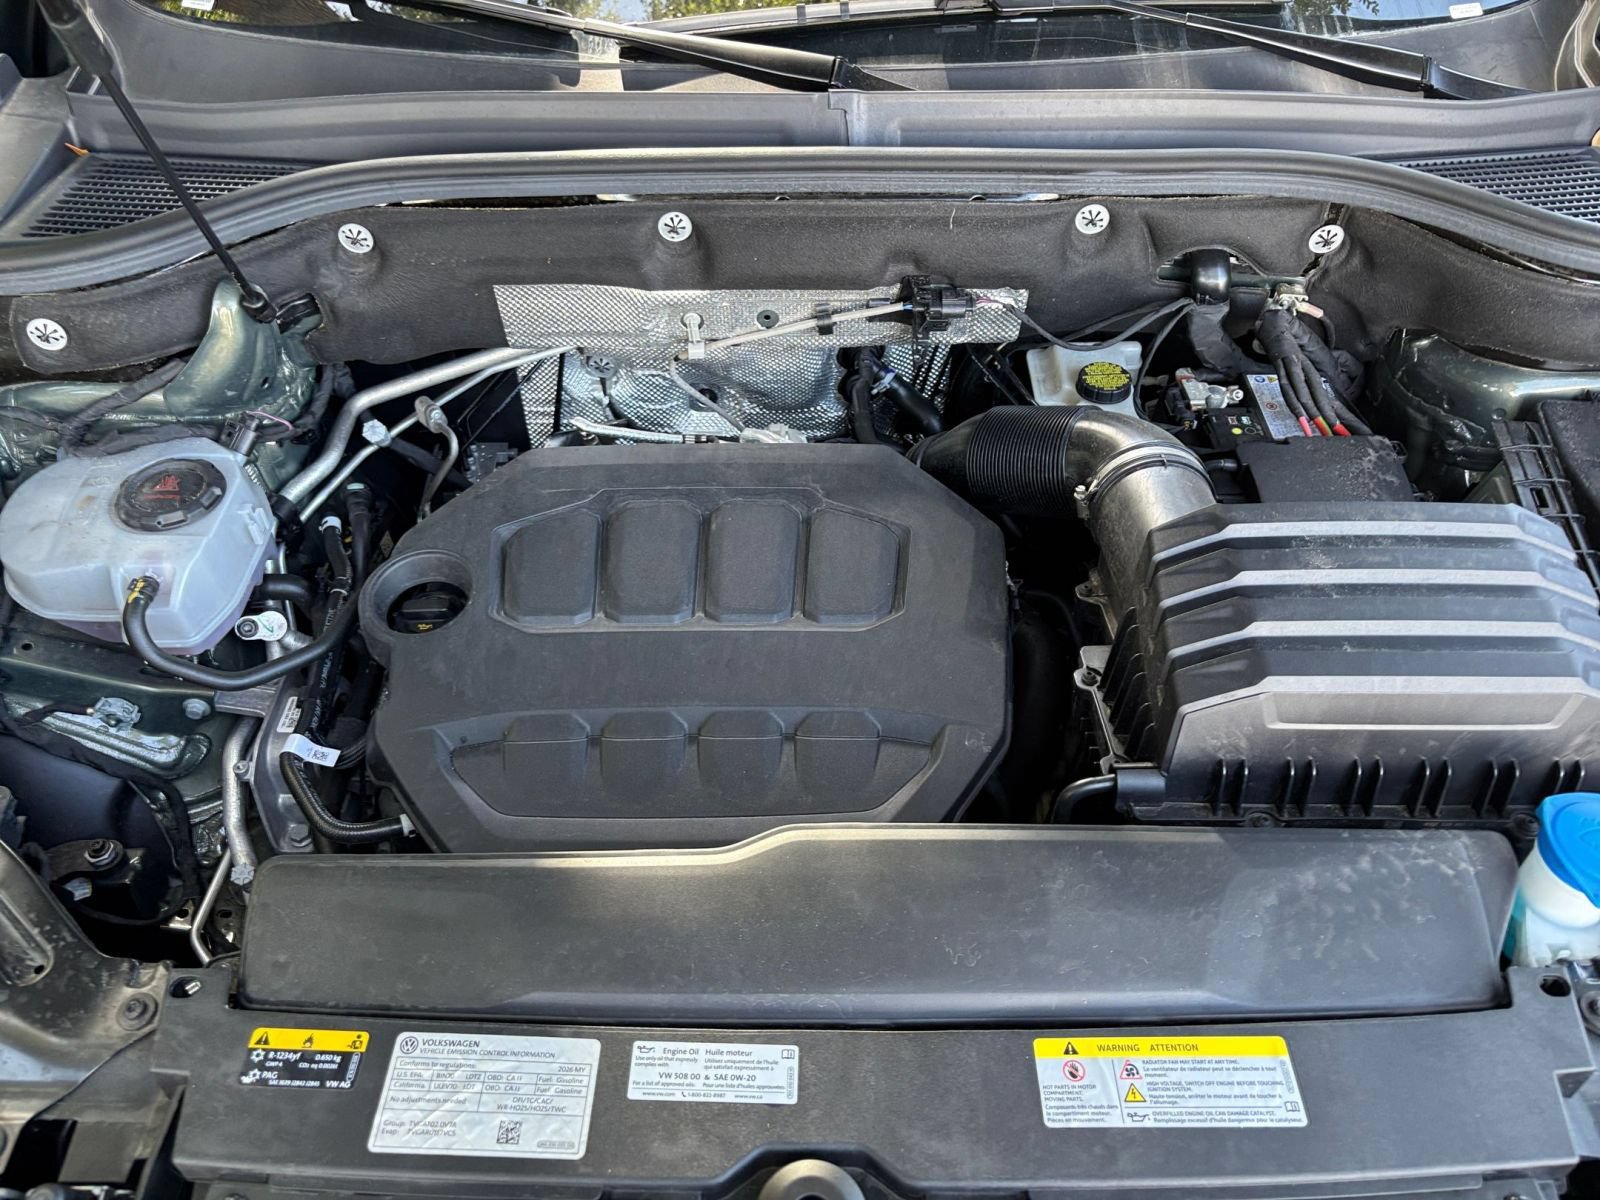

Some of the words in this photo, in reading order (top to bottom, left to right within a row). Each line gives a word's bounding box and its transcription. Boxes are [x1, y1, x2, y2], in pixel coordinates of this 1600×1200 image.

[422, 1038, 480, 1048] VOLKSWAGEN
[663, 1048, 688, 1056] Engine
[1097, 1044, 1140, 1052] WARNING
[268, 1051, 302, 1062] R-1234yf
[262, 1071, 278, 1079] PAG
[556, 1076, 584, 1084] Gasoline
